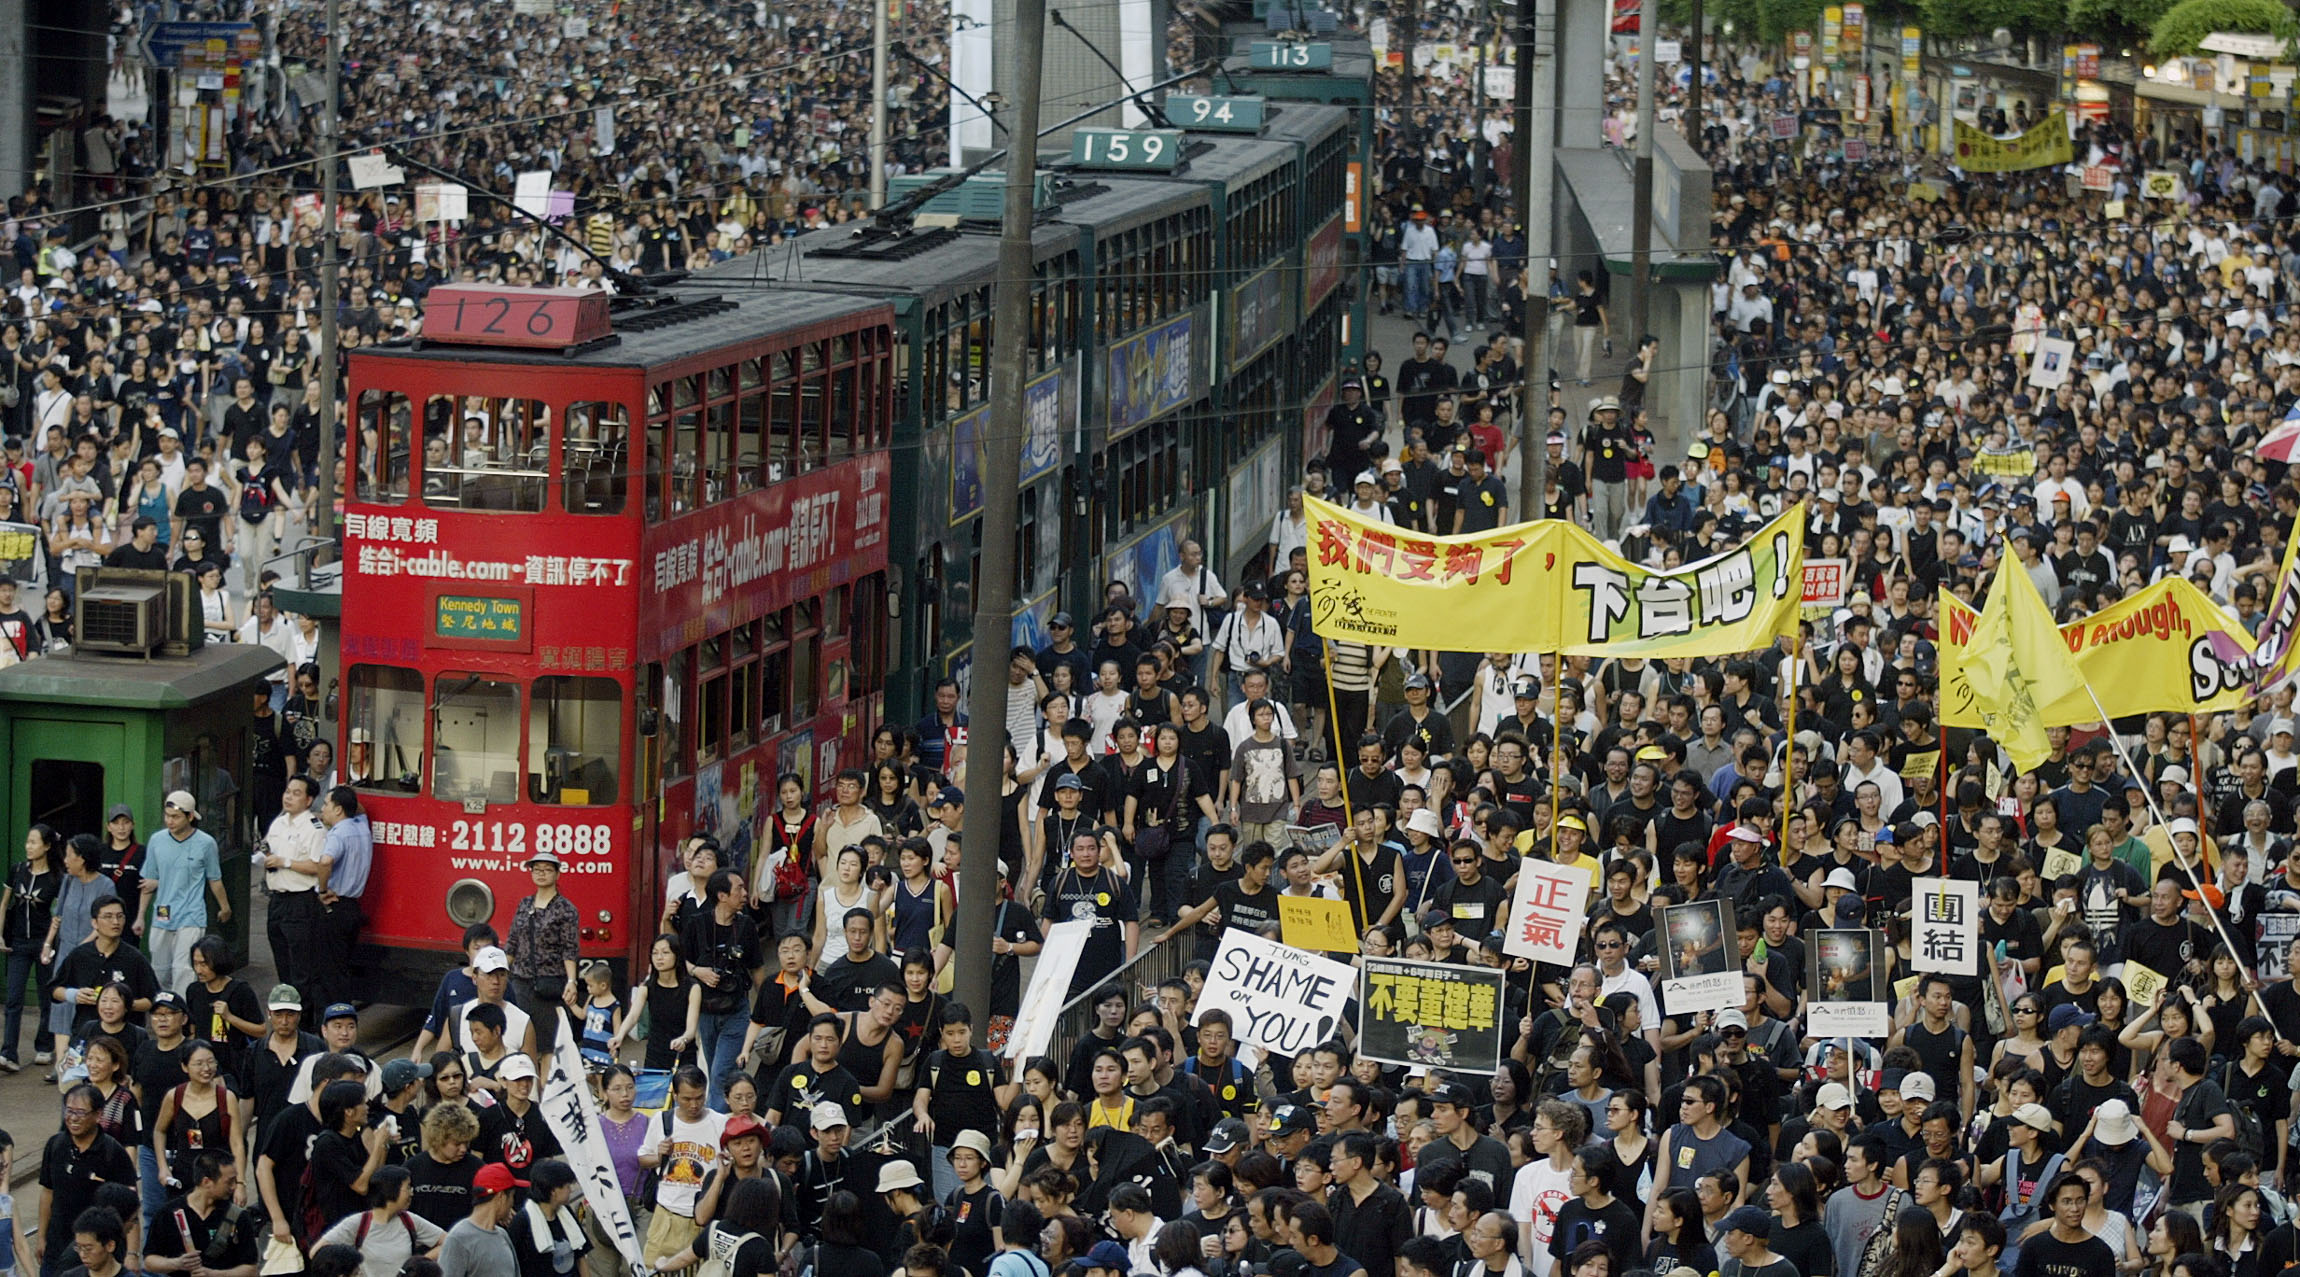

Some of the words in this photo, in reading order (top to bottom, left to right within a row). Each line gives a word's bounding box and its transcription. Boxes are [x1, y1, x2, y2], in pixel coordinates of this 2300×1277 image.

[1270, 45, 1311, 66] 113
[1192, 98, 1235, 124] 94
[1083, 133, 1165, 163] 159
[453, 296, 553, 336] 126
[344, 512, 439, 544] 有線寬頻
[654, 538, 698, 594] 有線寬頻
[440, 596, 487, 615] Kennedy
[491, 599, 519, 614] Town
[2090, 591, 2191, 646] enough,
[441, 613, 517, 632] 堅尼地城
[451, 820, 526, 852] 2112
[535, 824, 611, 855] 8888
[451, 855, 613, 874] www.i-ce.com
[1521, 874, 1573, 950] 正氣
[1923, 892, 1965, 963] 團結
[1268, 943, 1311, 966] TUNG
[1218, 946, 1336, 1012] SHAME
[1230, 989, 1253, 1005] ON
[1368, 972, 1496, 1033] 不要董建華
